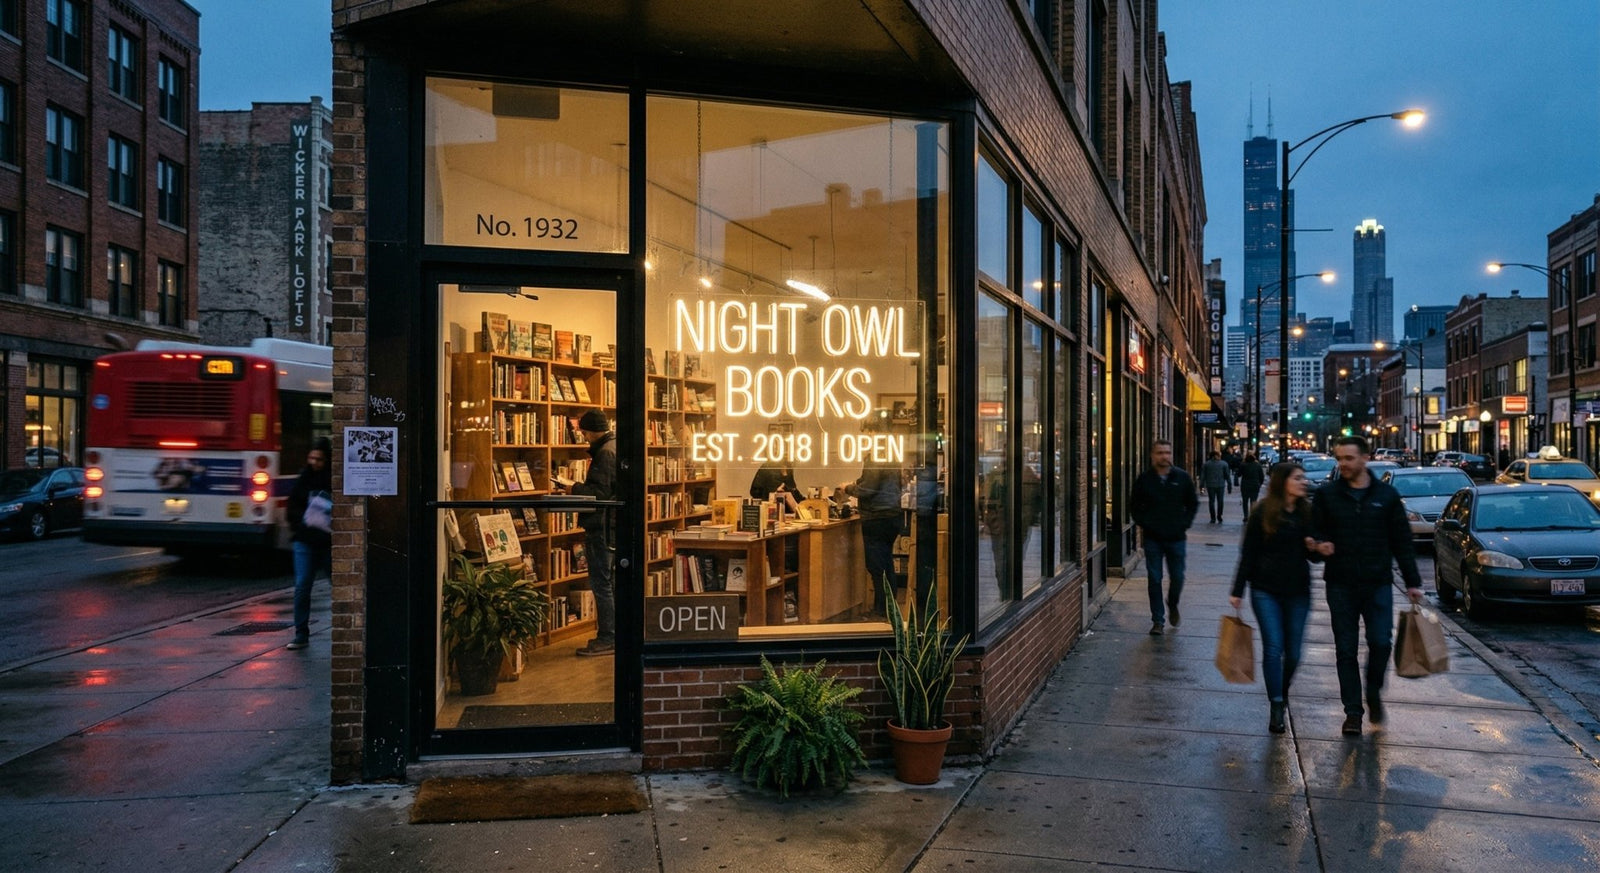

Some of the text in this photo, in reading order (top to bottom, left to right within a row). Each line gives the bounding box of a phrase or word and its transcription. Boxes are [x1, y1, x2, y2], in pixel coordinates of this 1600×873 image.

[293, 125, 308, 327] WICKER PARK LOFTS
[477, 213, 579, 240] No. 1932
[675, 298, 920, 357] NIGHT OWL
[725, 365, 871, 420] BOOKS
[692, 432, 743, 463] EST.
[752, 432, 812, 463] 2018
[838, 433, 904, 463] OPEN
[659, 605, 726, 633] OPEN
